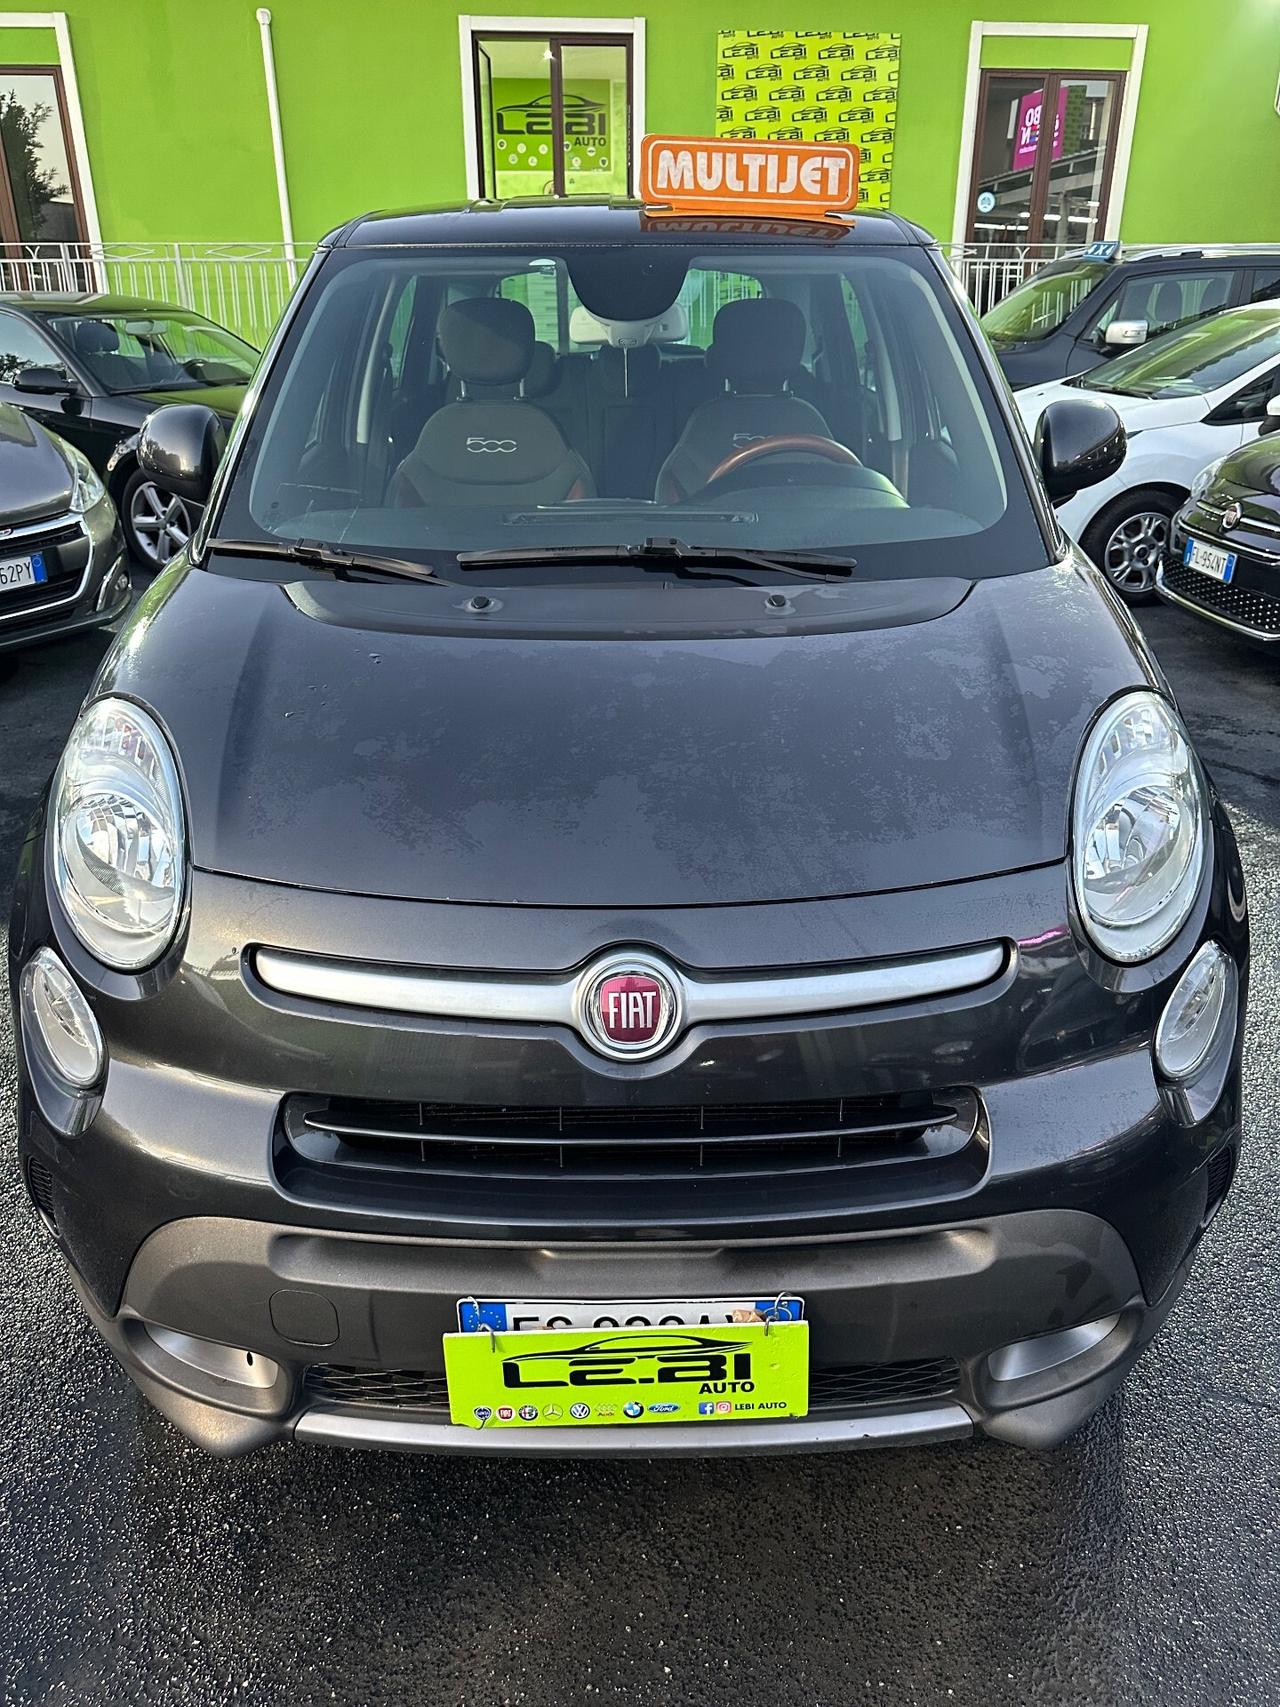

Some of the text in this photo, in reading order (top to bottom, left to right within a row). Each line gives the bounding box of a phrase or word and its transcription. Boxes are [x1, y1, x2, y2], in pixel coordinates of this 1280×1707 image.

[574, 137, 607, 147] AUTO
[656, 149, 846, 196] MULTIJET
[466, 437, 517, 453] 500
[608, 992, 657, 1029] FIAT
[699, 1382, 755, 1394] AUTO
[653, 1404, 673, 1412] Ford
[735, 1401, 787, 1411] LEBI AUTO
